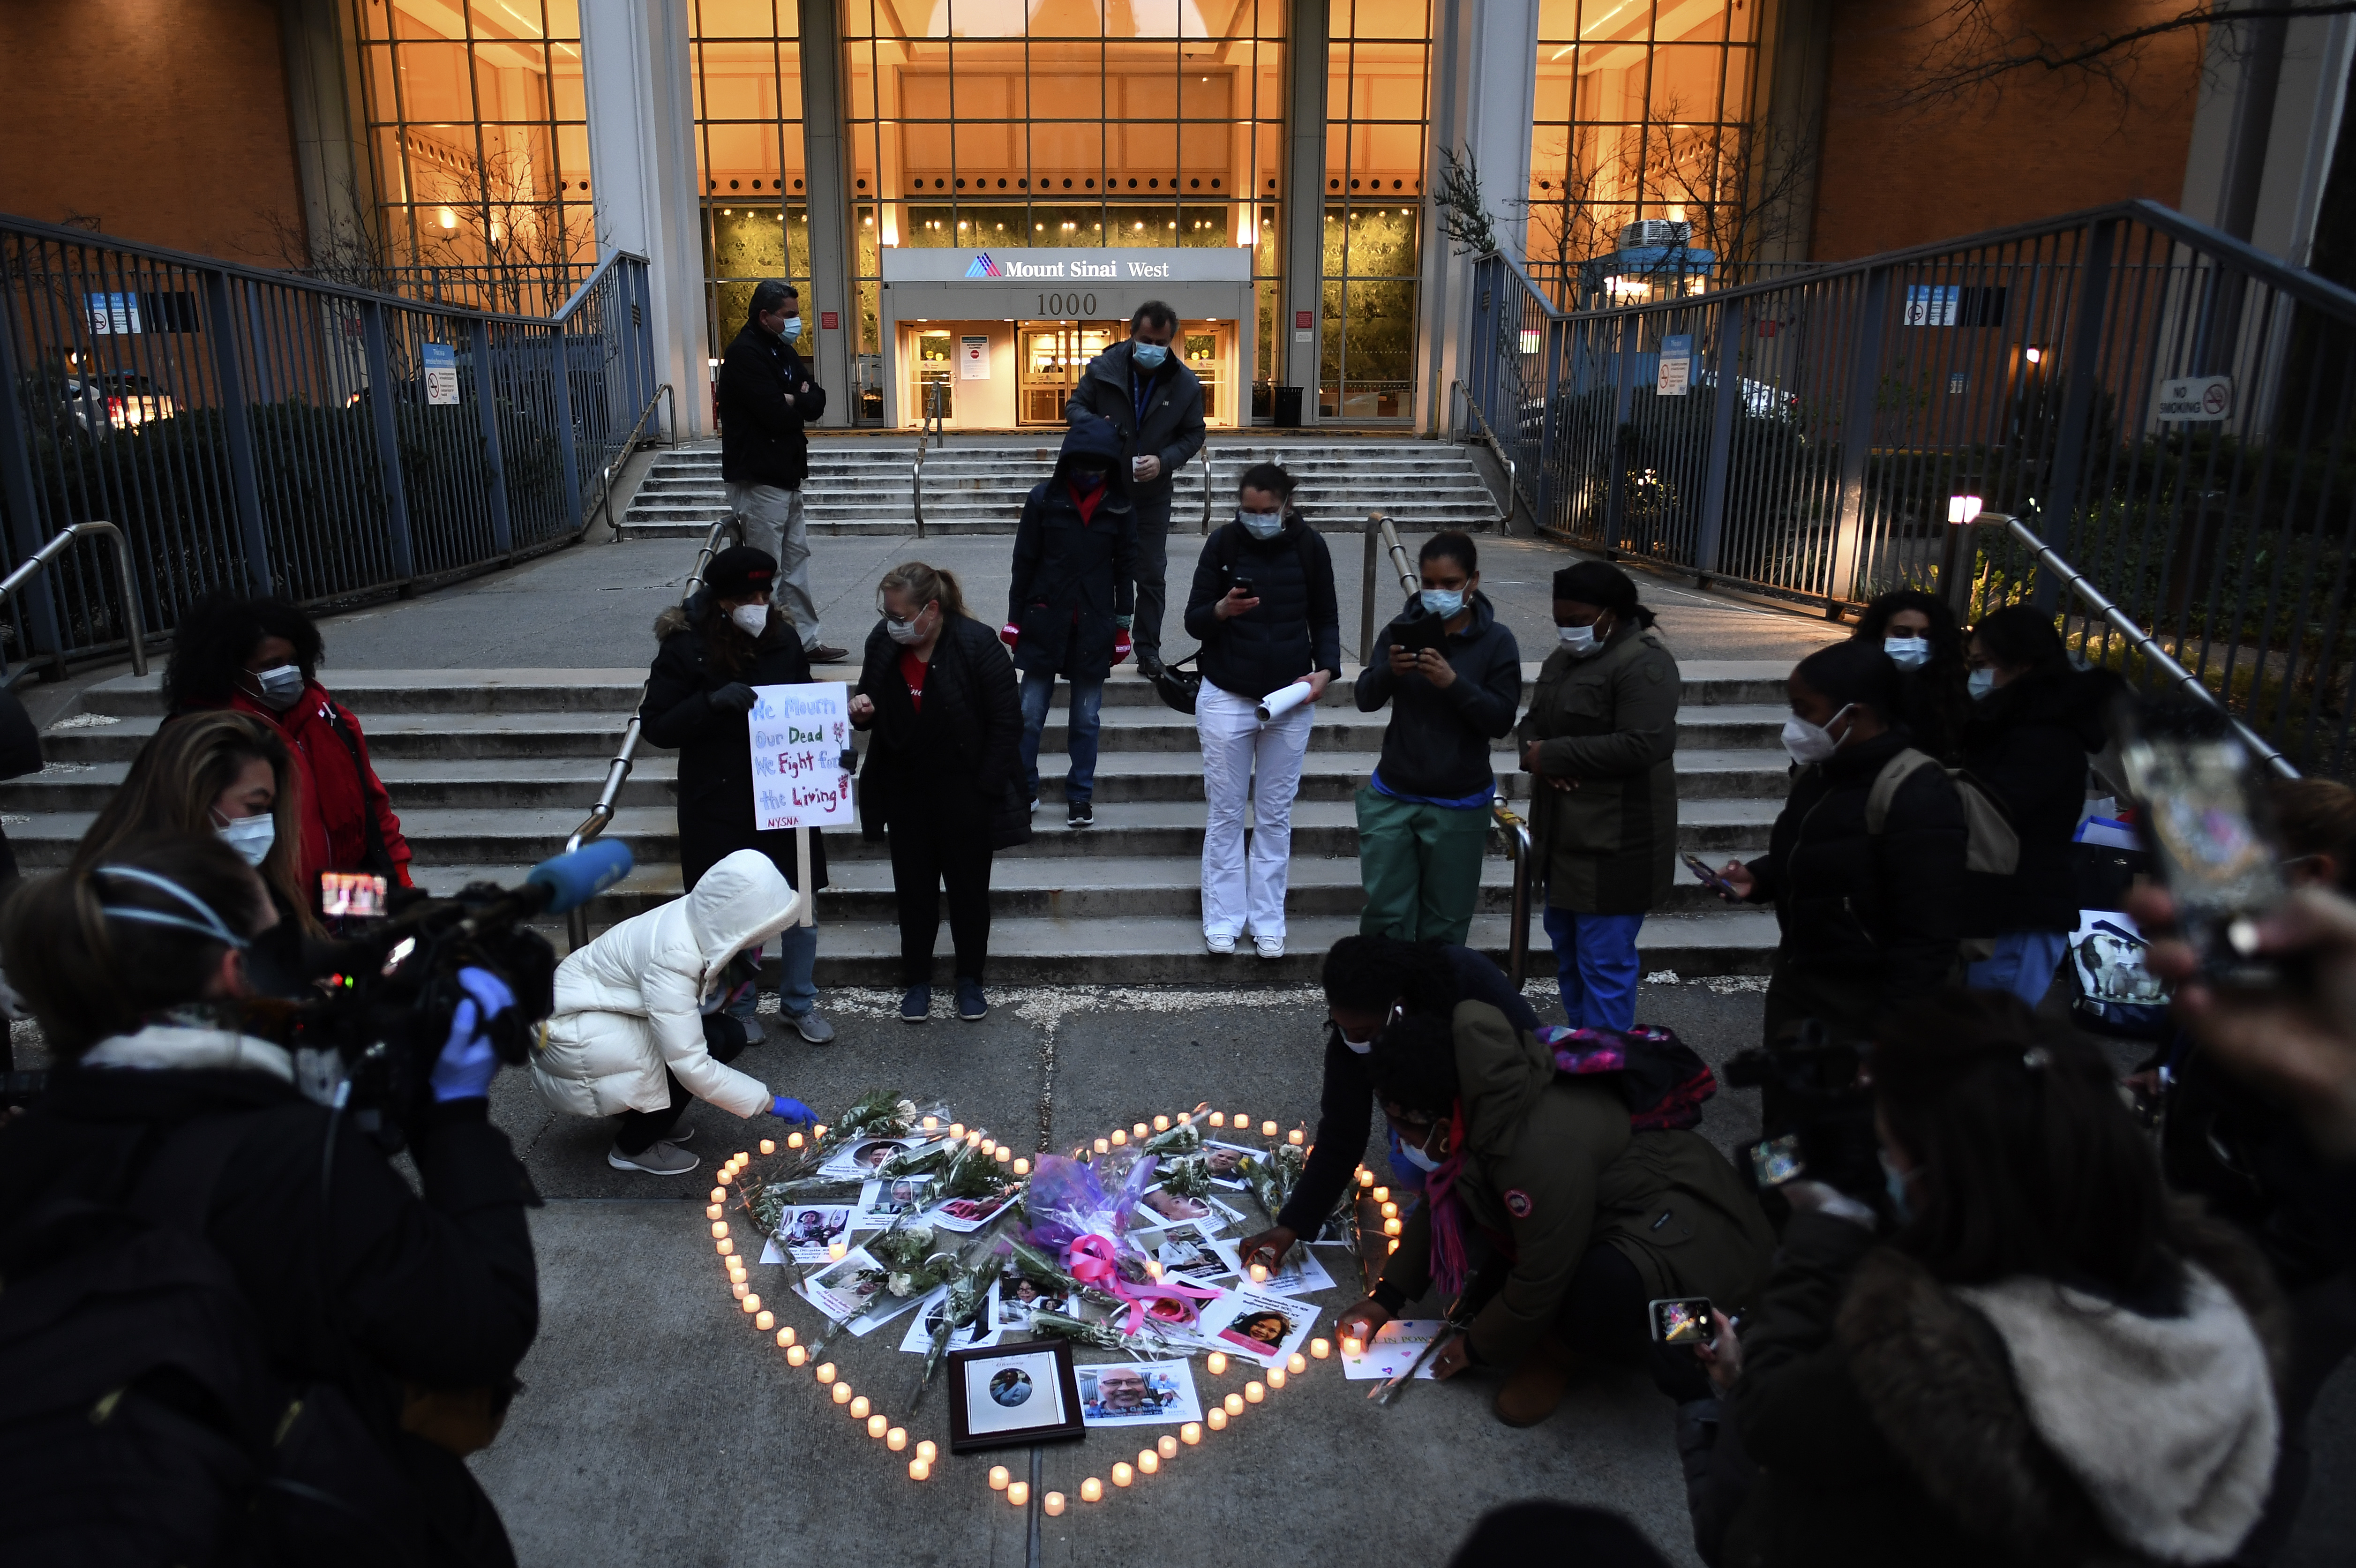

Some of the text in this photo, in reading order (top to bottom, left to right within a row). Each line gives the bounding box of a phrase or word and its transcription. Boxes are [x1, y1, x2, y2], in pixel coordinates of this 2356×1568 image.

[1005, 260, 1169, 277] Mount Sinai West
[1038, 293, 1096, 315] 1000
[751, 696, 836, 721] We Mourn
[756, 724, 823, 749] Our Dead
[755, 756, 776, 777] We
[778, 750, 814, 779] Fight
[760, 789, 786, 810] the
[768, 817, 800, 828] NYSNA
